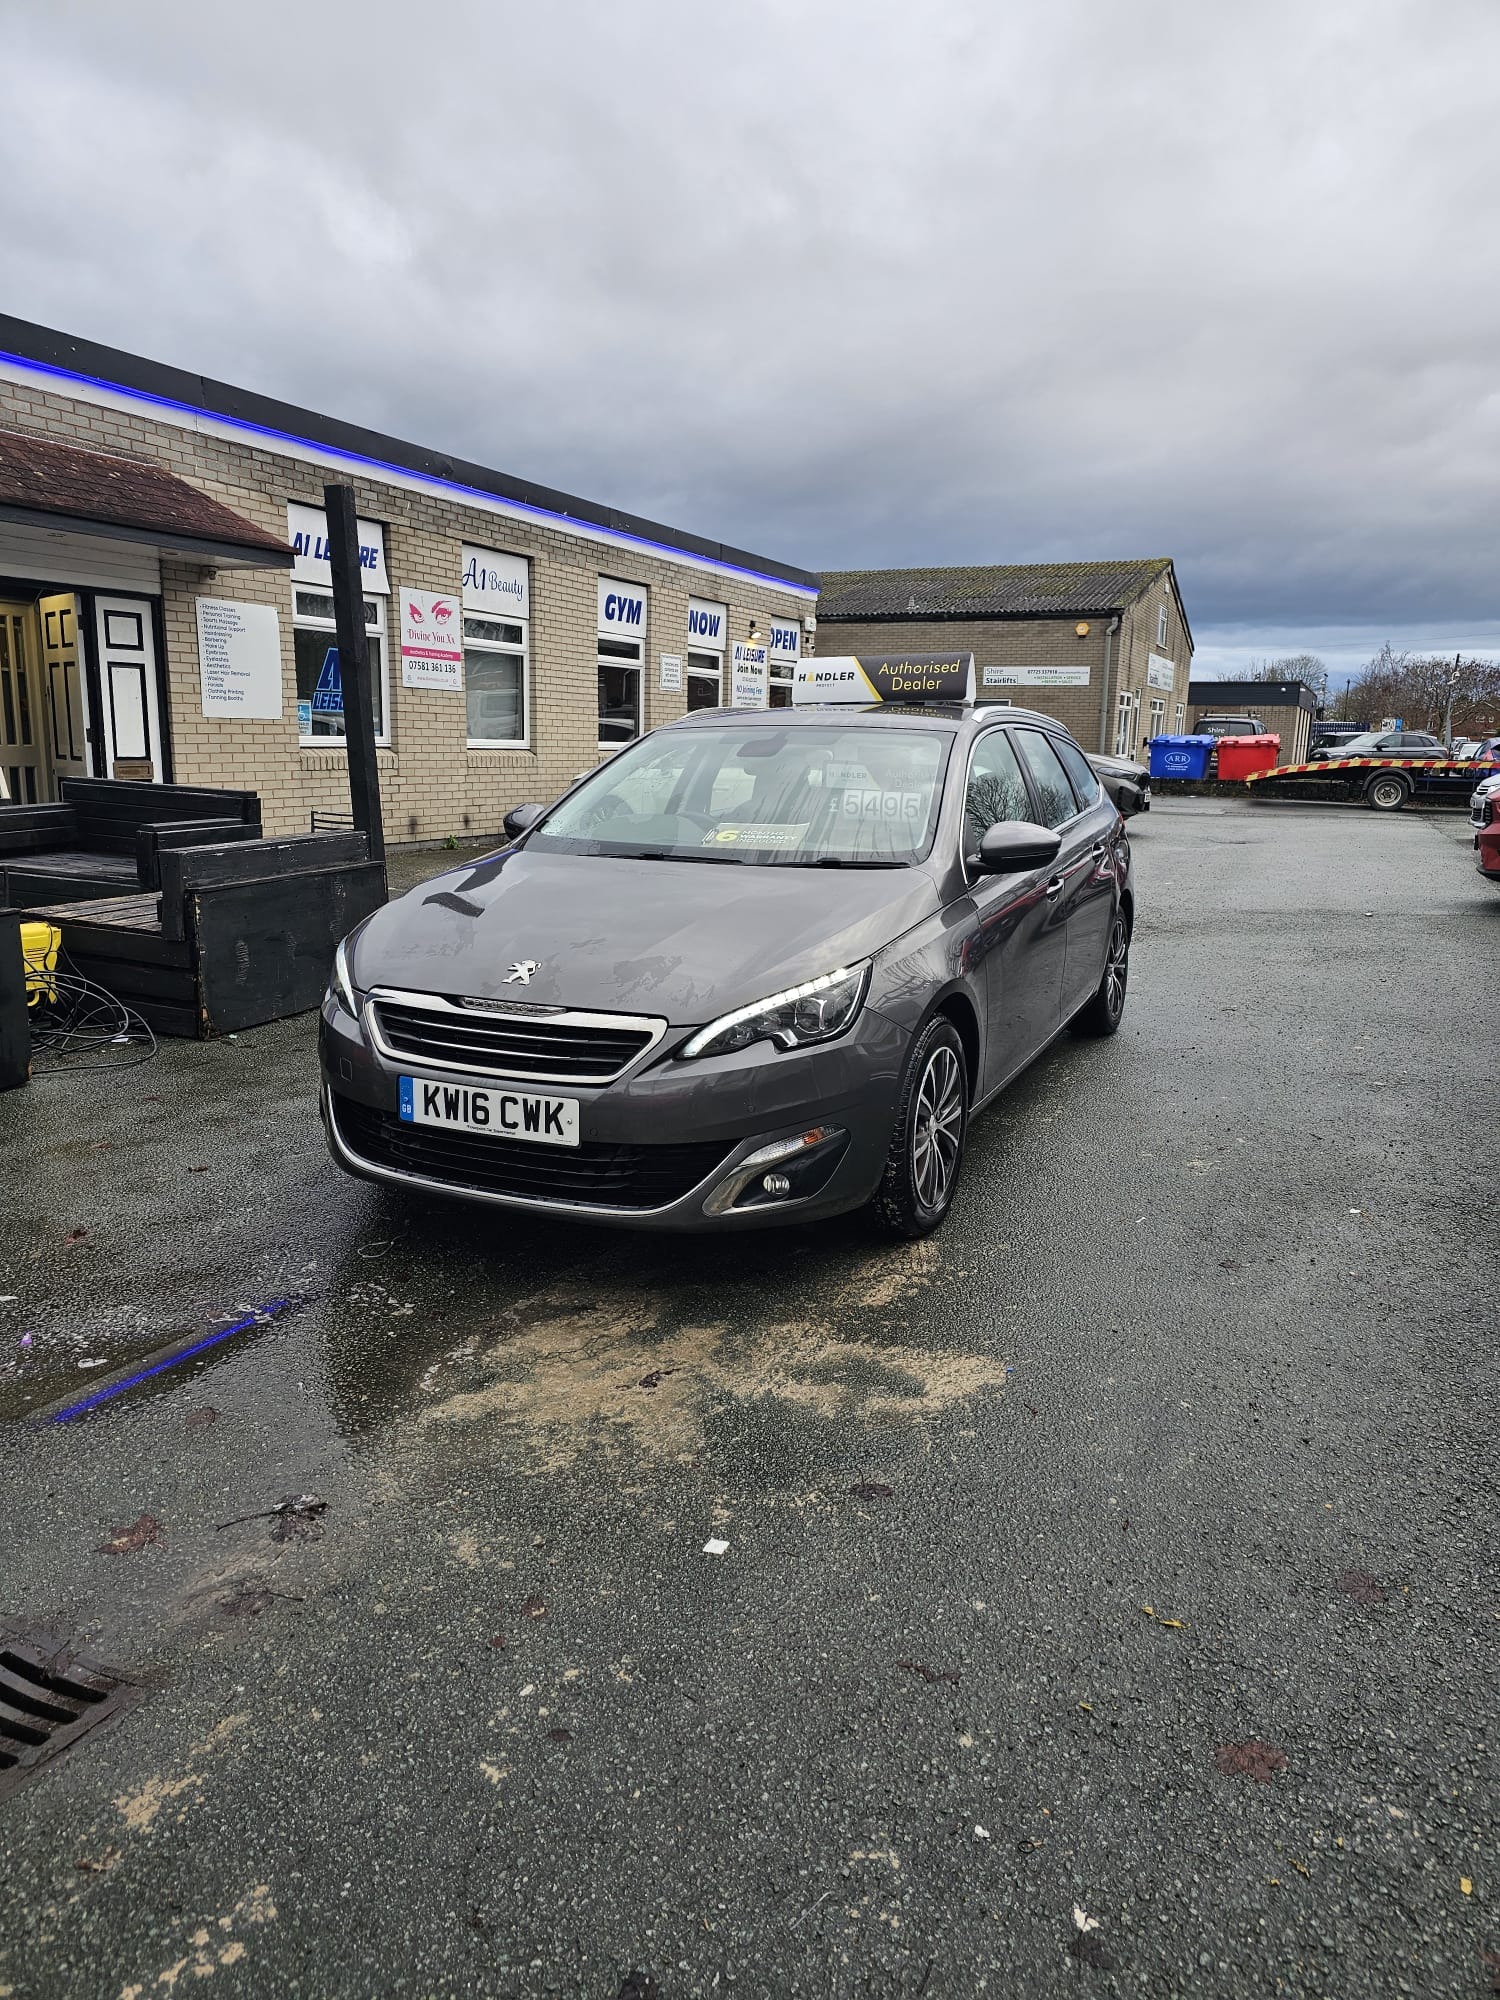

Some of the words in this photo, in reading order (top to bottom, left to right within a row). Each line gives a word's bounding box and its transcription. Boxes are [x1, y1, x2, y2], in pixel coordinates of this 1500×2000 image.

[314, 536, 379, 570] LERE
[462, 557, 487, 591] A1
[489, 570, 523, 602] Beauty
[202, 603, 219, 611] Fitness
[604, 594, 643, 626] GYM
[218, 618, 239, 626] Massage
[688, 609, 721, 638] NOW
[407, 629, 431, 642] Divine
[431, 632, 445, 646] You
[743, 648, 765, 664] LEISURE
[408, 660, 429, 671] 07581
[431, 662, 443, 672] 361
[737, 663, 749, 673] Join
[750, 665, 762, 675] Now
[878, 659, 961, 676] Authorised
[986, 667, 1004, 675] Shire
[892, 677, 943, 691] Dealer
[402, 1104, 412, 1114] GB
[423, 1084, 490, 1126] KW16
[500, 1095, 565, 1136] CWK
